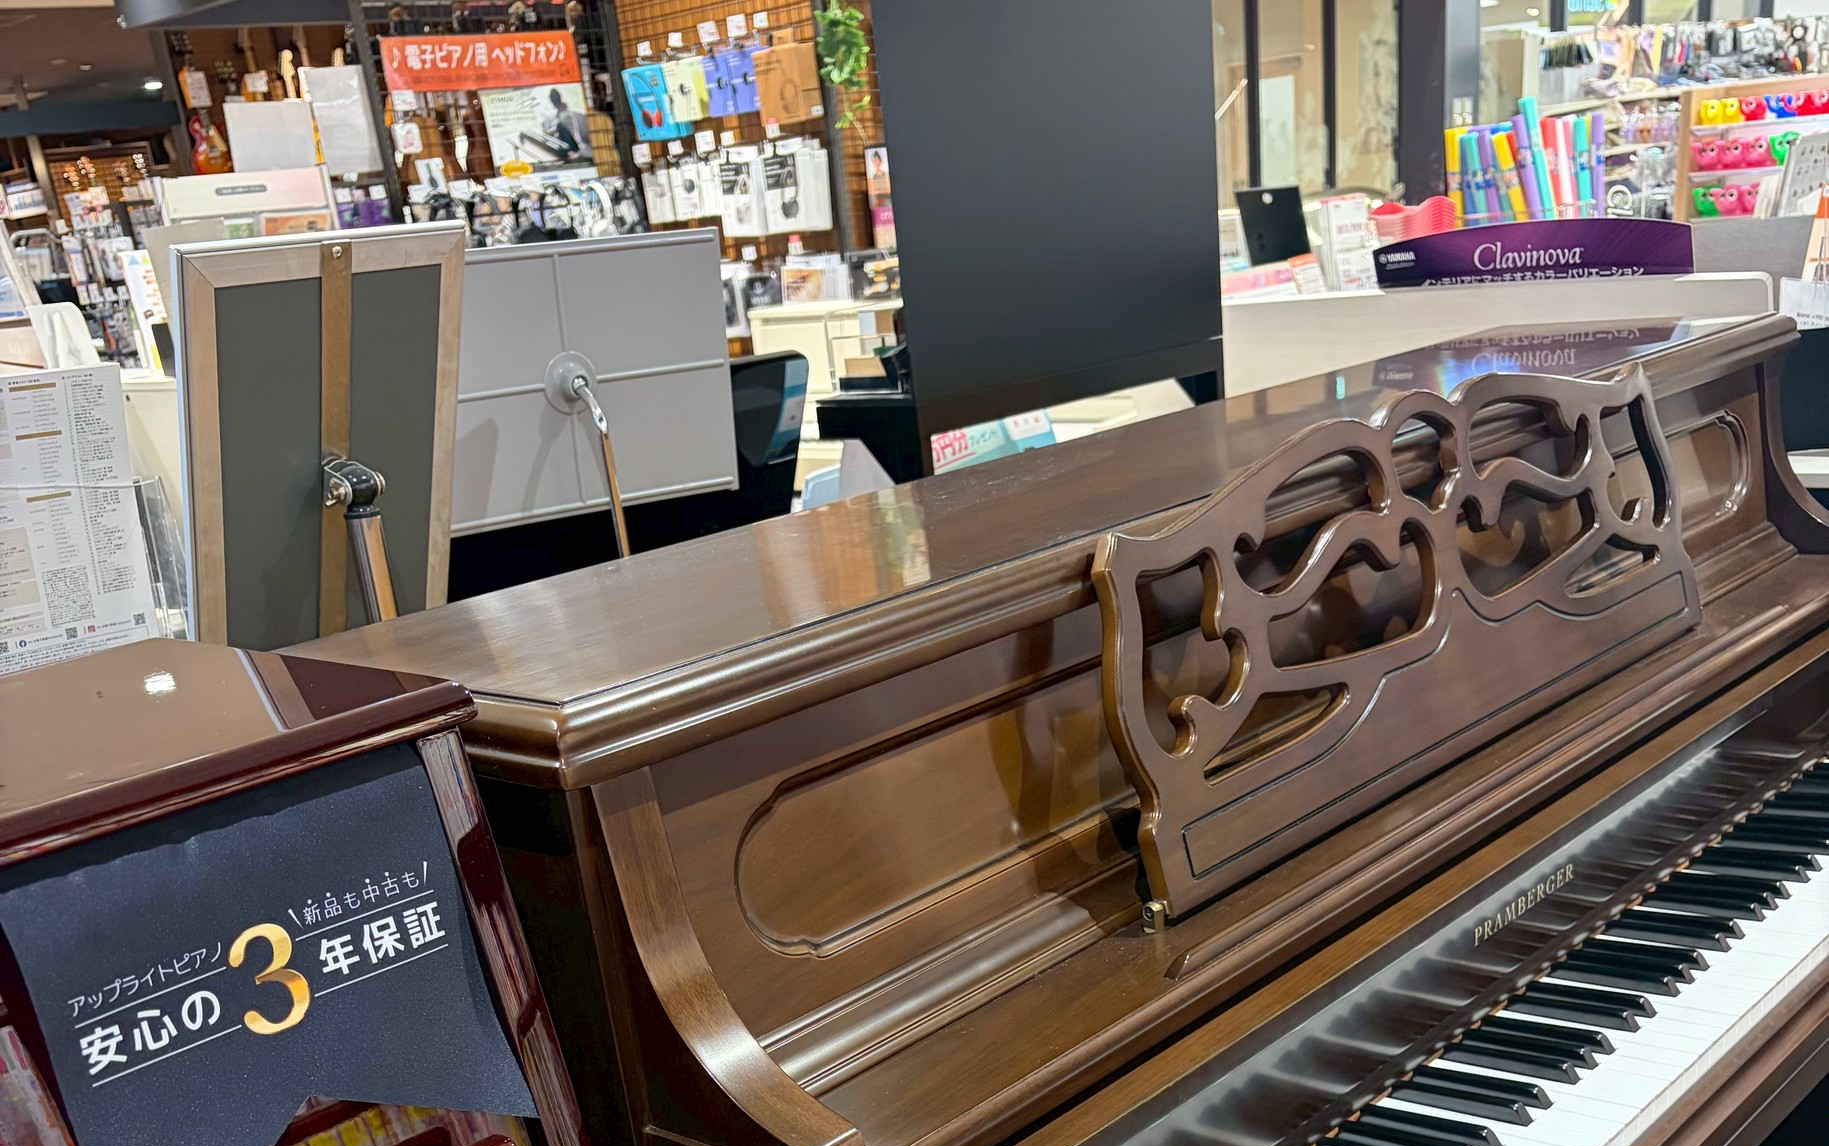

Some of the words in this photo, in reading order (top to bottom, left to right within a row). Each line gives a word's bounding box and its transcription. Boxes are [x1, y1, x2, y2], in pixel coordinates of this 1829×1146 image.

[1473, 242, 1582, 271] Clavinova
[302, 871, 419, 925] 新品も中古も
[1473, 863, 1574, 947] PRAMBERGER
[67, 942, 222, 1017] アップライトピアノ
